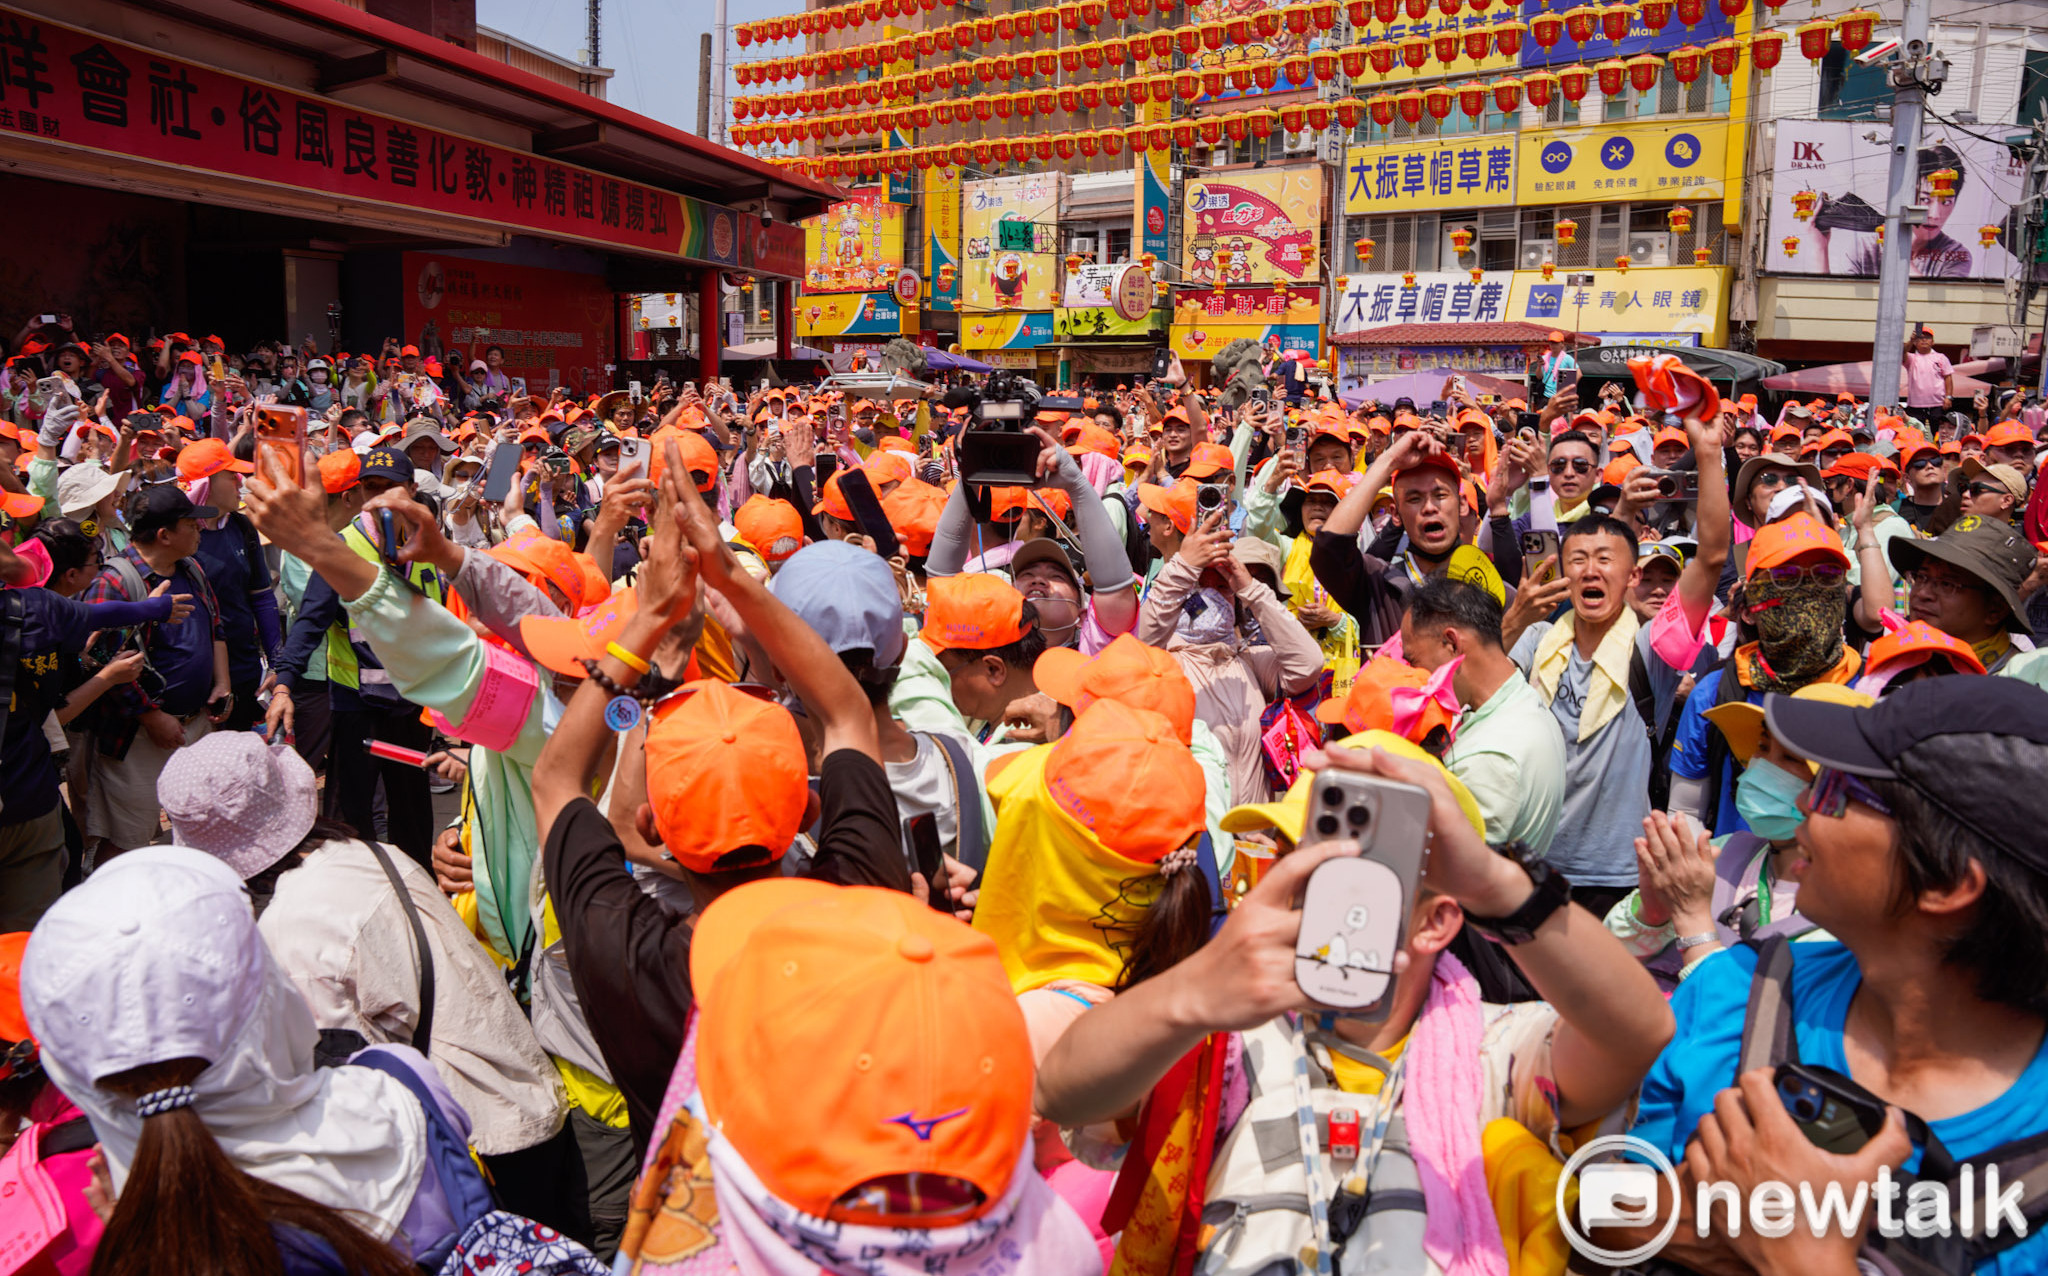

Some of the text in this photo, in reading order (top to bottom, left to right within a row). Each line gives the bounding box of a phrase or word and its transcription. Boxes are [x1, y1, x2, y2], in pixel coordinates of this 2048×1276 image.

[1793, 141, 1825, 161] DK
[1349, 146, 1512, 202] 大振草帽草蓆
[1593, 177, 1638, 189] 免費保養
[1205, 295, 1287, 317] 補財庫
[1344, 282, 1504, 323] 大振草帽草蓆
[1571, 289, 1703, 309] 年青人眼鏡
[1206, 336, 1242, 347] 公益彩
